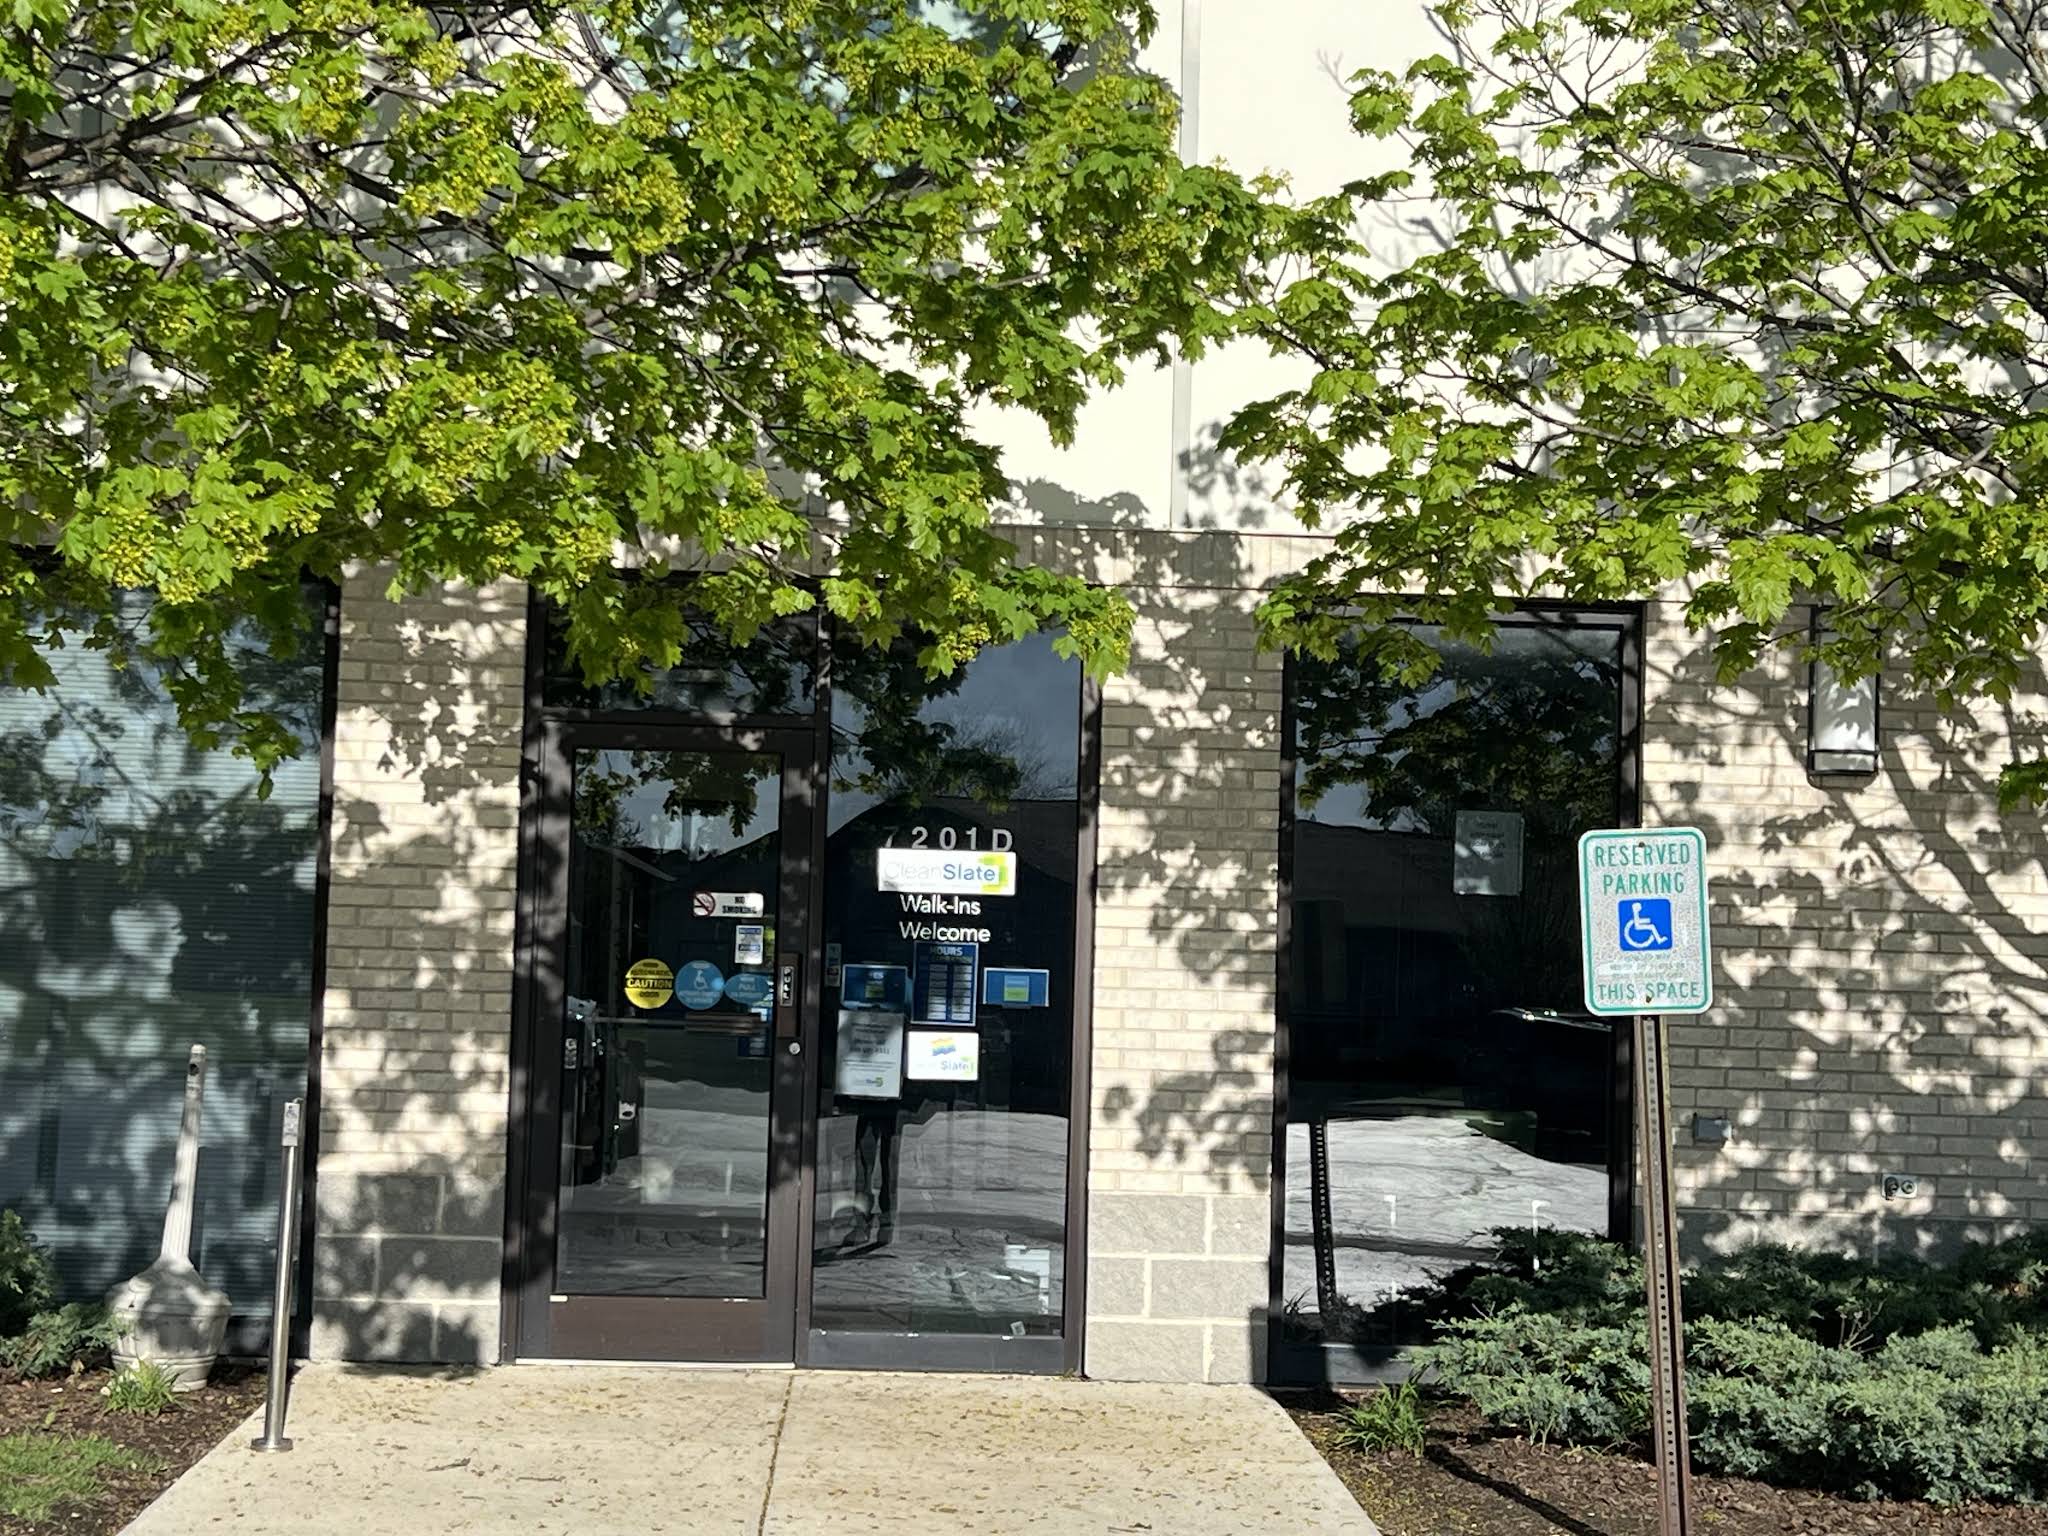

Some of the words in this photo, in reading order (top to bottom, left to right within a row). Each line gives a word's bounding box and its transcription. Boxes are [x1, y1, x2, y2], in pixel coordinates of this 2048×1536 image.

[1595, 843, 1690, 867] RESERVED
[1602, 872, 1685, 895] PARKING
[900, 894, 981, 915] Walk-Ins
[899, 921, 991, 942] Welcome
[627, 979, 672, 988] CAUTION
[1598, 983, 1635, 1000] THIS
[1645, 981, 1700, 999] SPACE
